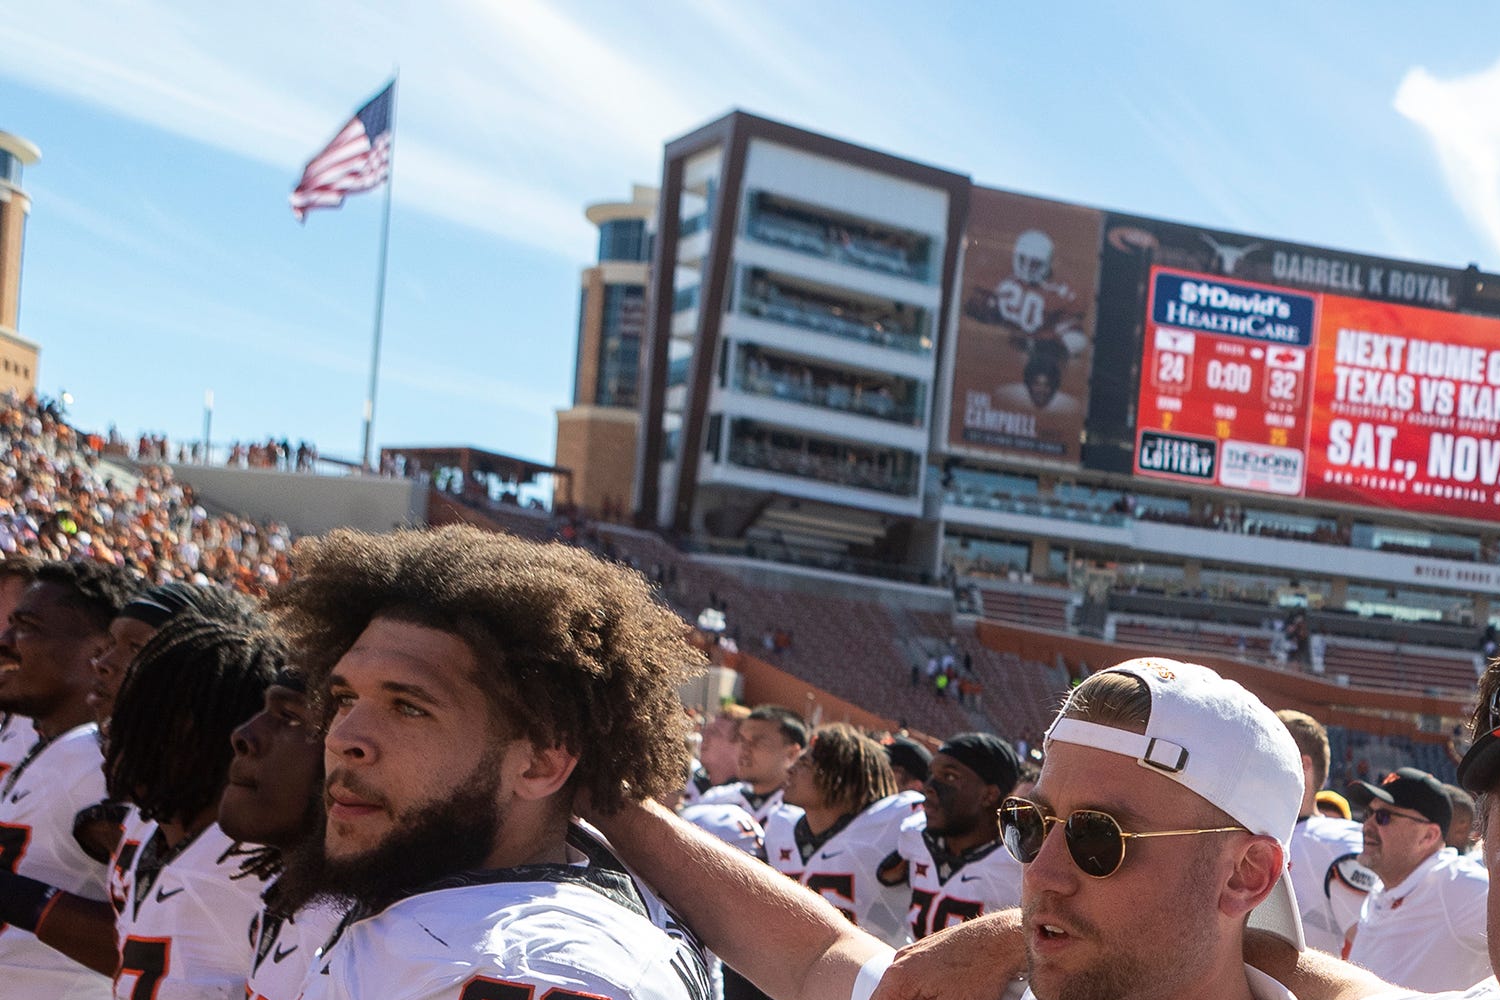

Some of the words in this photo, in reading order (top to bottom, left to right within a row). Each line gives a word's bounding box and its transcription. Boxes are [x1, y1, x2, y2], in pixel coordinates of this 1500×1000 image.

[1273, 251, 1361, 292] DARRELL
[1369, 267, 1384, 295] K
[1388, 269, 1453, 306] ROYAL
[997, 278, 1045, 333] 20
[1159, 352, 1185, 383] 24
[1206, 359, 1252, 394] 0:00
[1335, 328, 1407, 372] NEXT
[1406, 338, 1487, 383] HOME
[1269, 370, 1297, 400] 32
[1334, 366, 1415, 411] TEXAS
[1419, 378, 1456, 416] VS
[1141, 445, 1213, 476] LOTTERY
[1327, 418, 1418, 481] SAT.,
